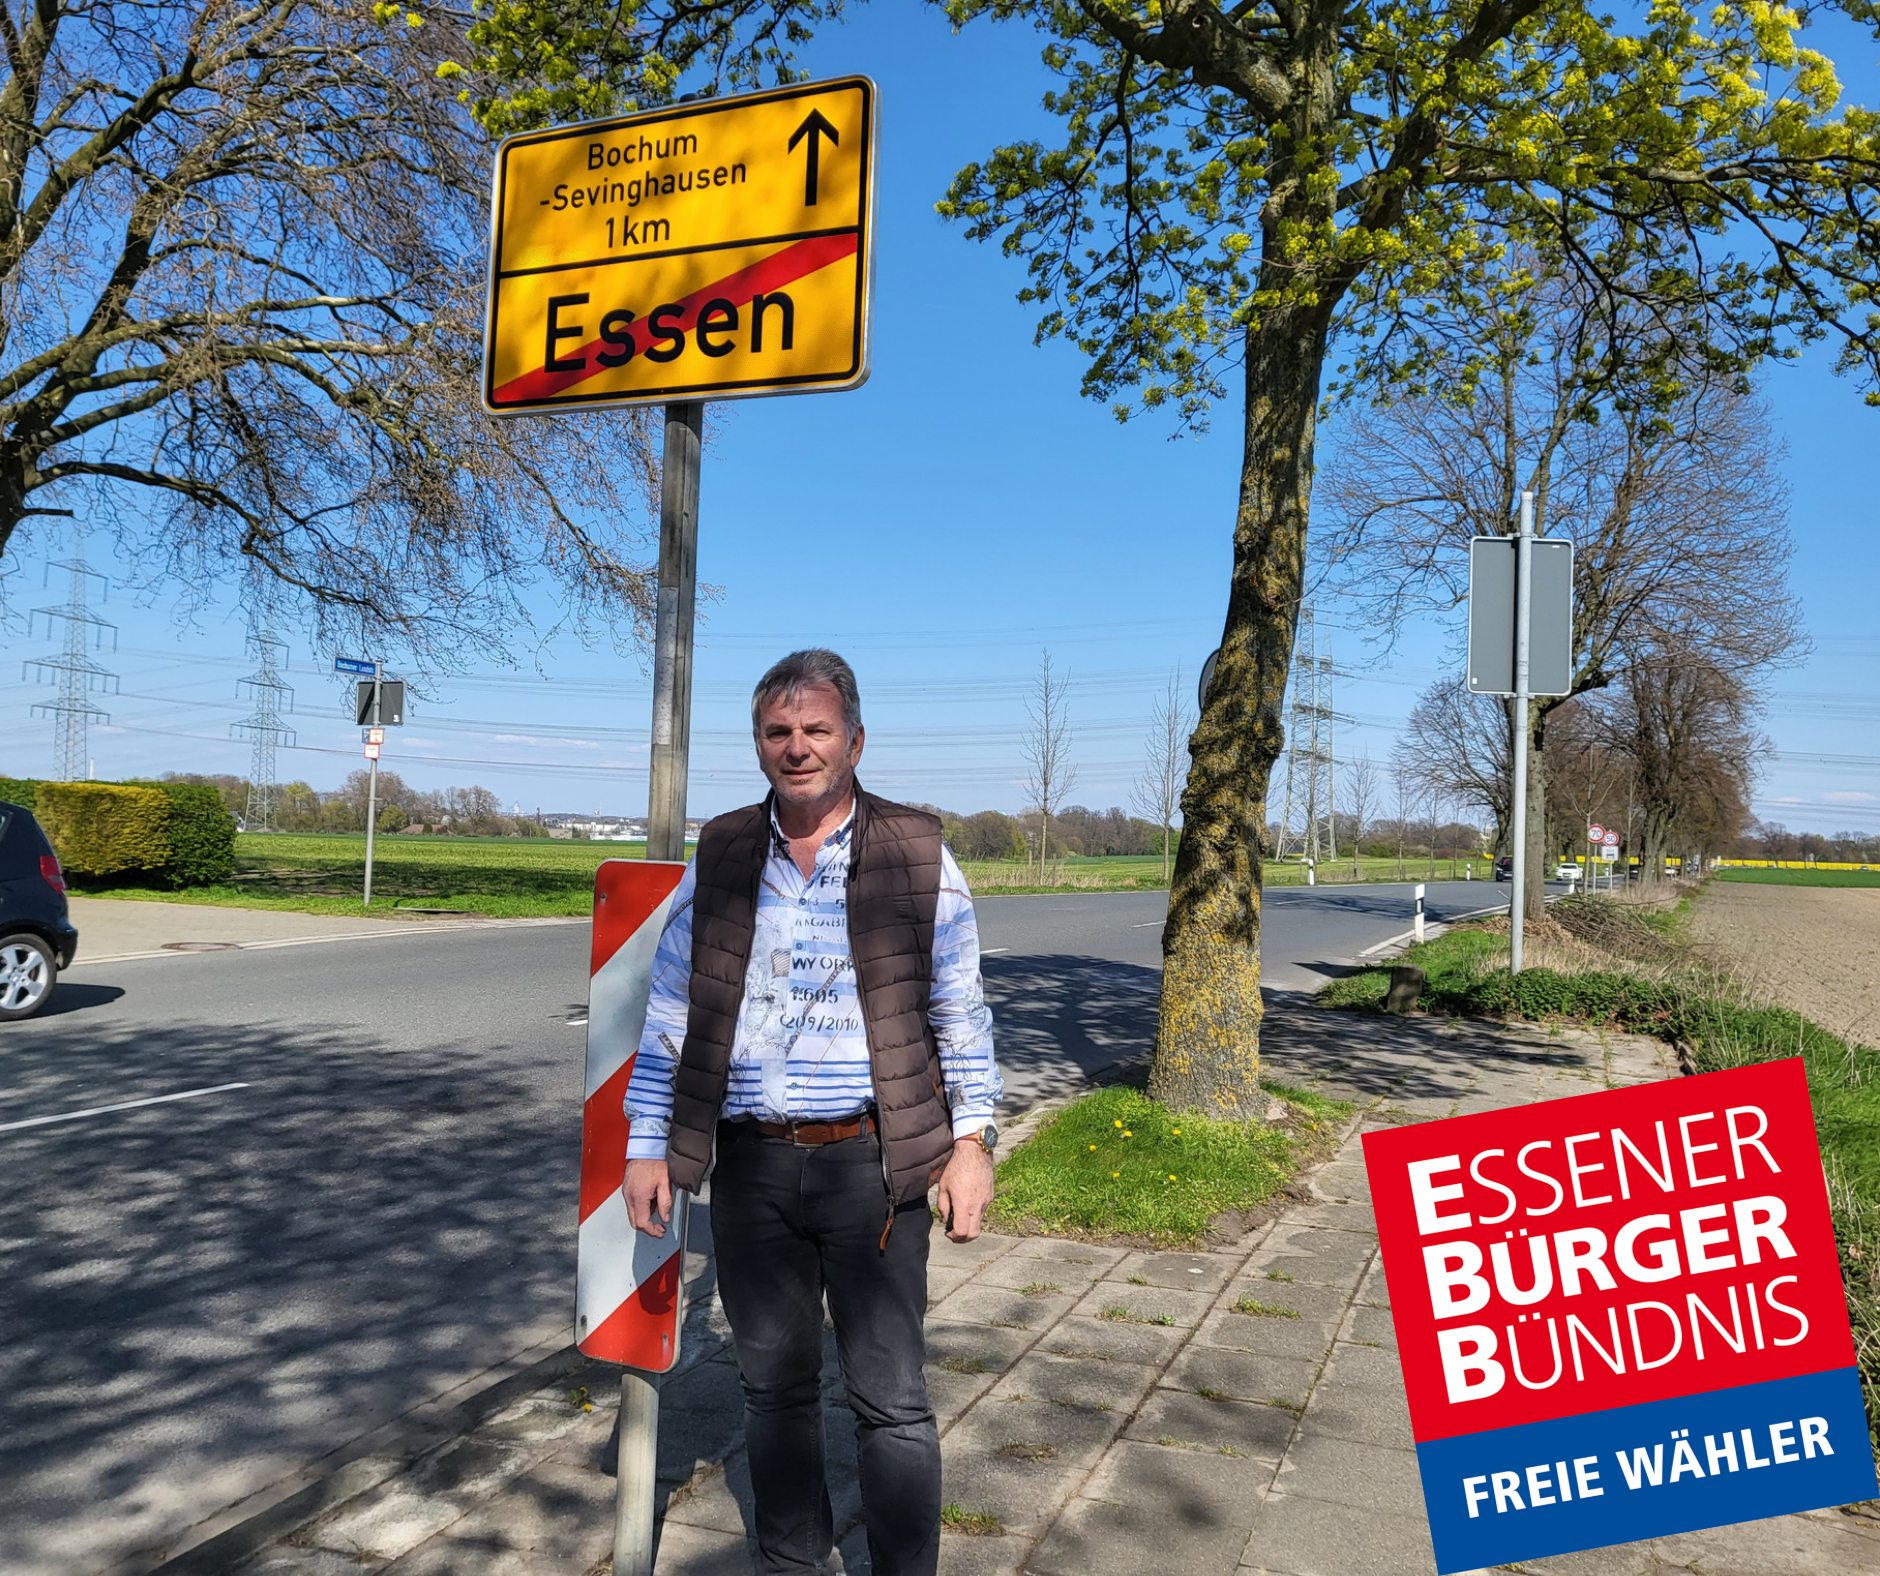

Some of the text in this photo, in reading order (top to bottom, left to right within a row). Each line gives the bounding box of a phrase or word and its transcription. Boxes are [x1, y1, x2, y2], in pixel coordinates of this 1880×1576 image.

[587, 133, 698, 171] Bochum
[540, 162, 747, 211] -Sevinghausen
[544, 291, 795, 374] Essen
[1591, 830, 1602, 838] 70
[1606, 835, 1616, 843] 50
